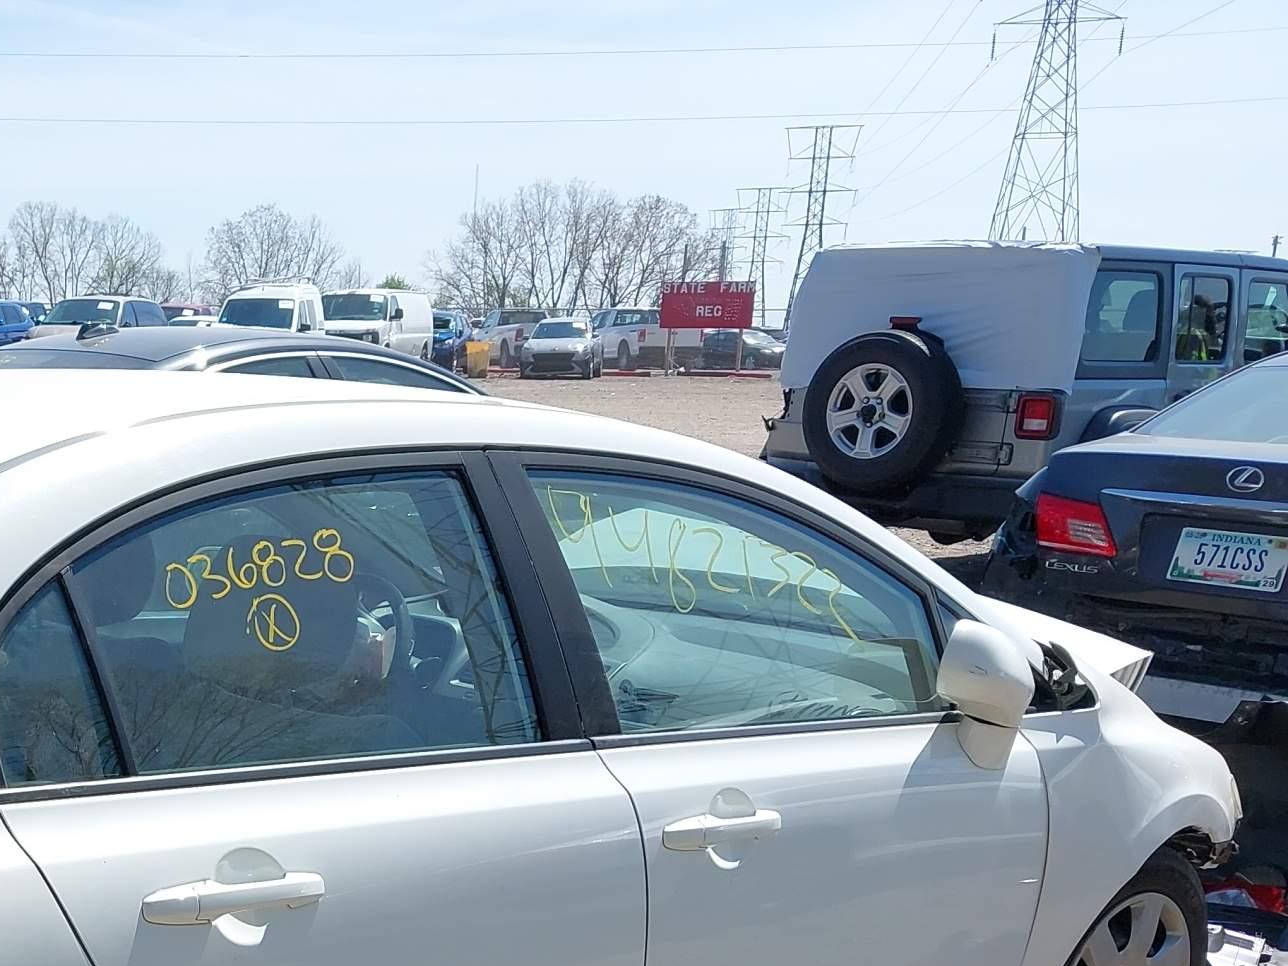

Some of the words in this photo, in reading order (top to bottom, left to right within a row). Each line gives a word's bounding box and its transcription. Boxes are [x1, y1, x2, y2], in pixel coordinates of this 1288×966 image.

[663, 282, 707, 294] STATE
[720, 282, 756, 293] FARM
[695, 305, 723, 317] REG
[1211, 533, 1262, 547] INDIANA
[1193, 542, 1269, 573] 571CSS
[165, 528, 355, 609] 036828
[1045, 559, 1099, 574] LEXUS
